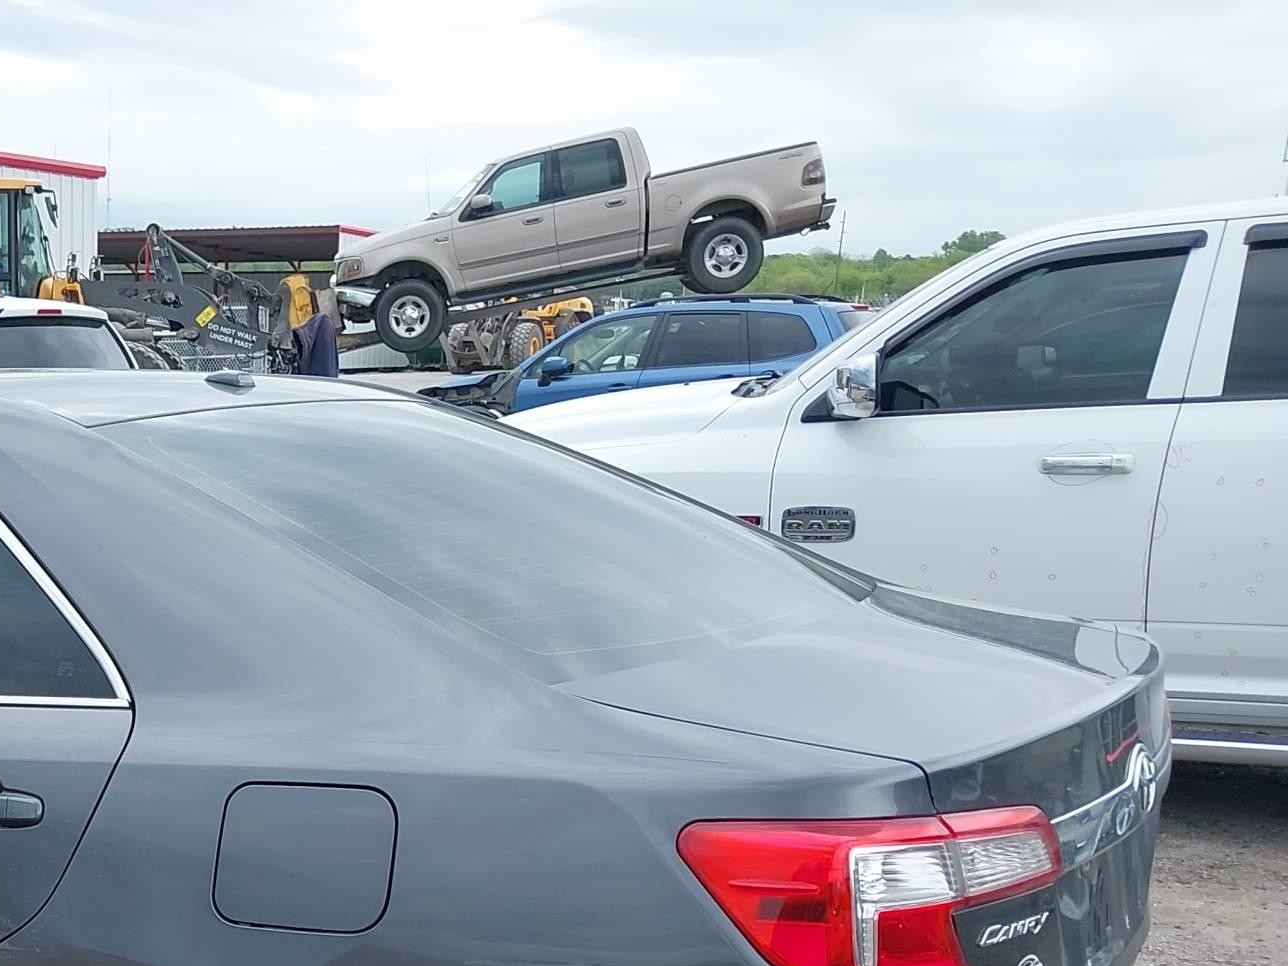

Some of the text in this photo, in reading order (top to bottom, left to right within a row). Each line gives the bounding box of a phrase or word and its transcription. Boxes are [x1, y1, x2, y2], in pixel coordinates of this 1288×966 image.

[207, 322, 258, 342] DO NOT WALK
[209, 331, 254, 350] UNDER MAST
[785, 519, 851, 532] RAM
[977, 911, 1050, 947] CAMRY
